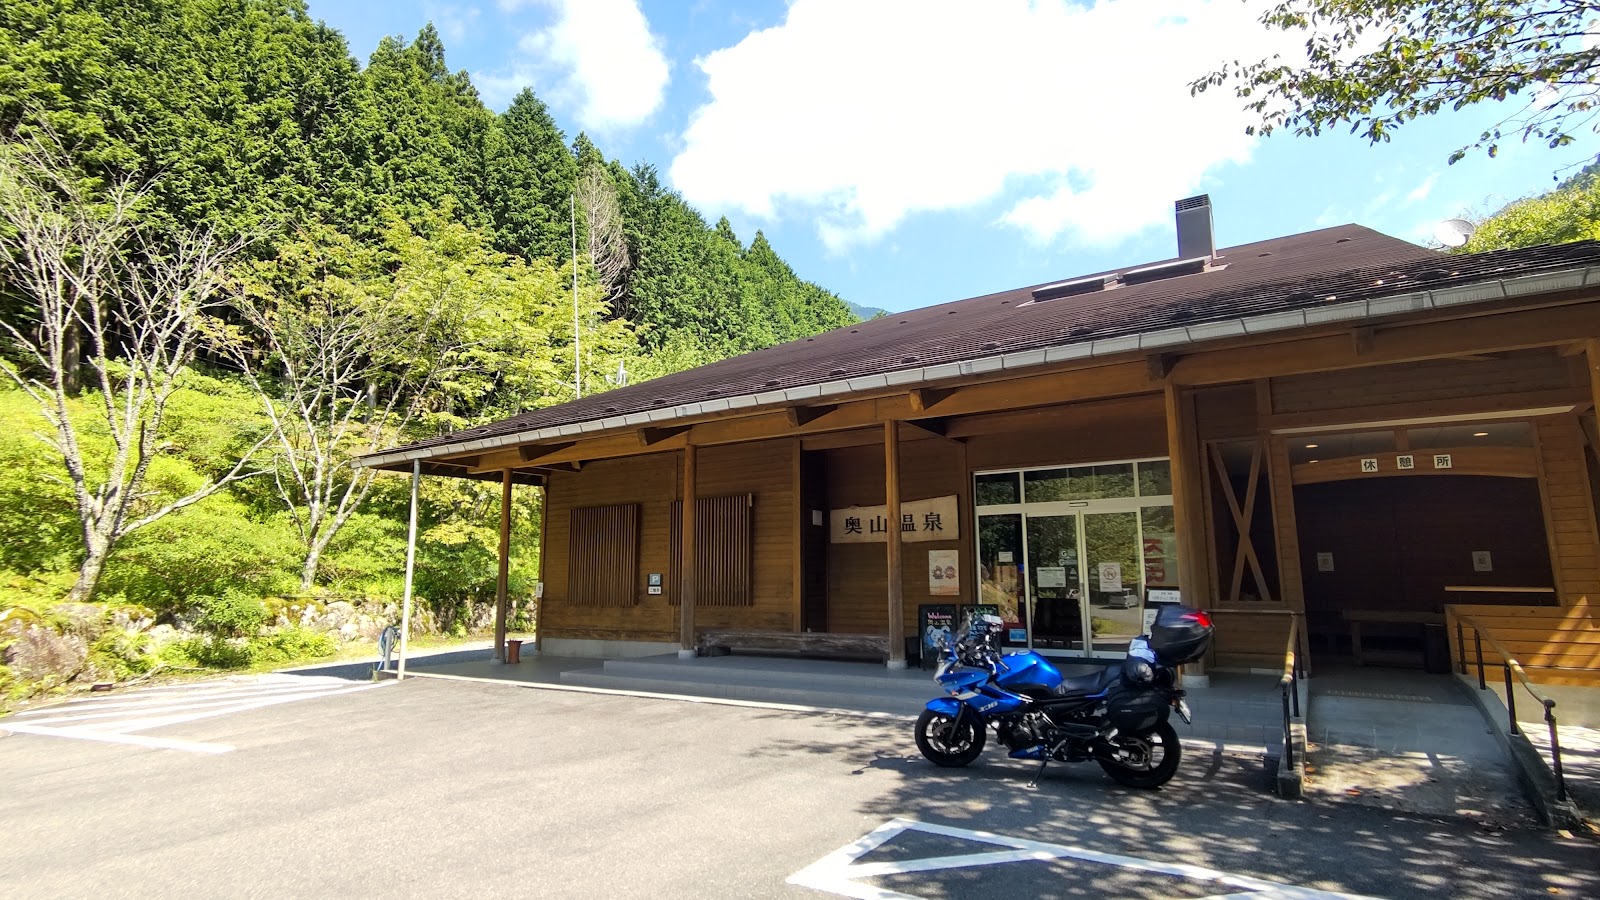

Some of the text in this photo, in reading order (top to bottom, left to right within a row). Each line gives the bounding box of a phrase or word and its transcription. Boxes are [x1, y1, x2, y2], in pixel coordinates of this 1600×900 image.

[1363, 456, 1449, 470] 休憩所
[844, 512, 943, 534] 奥山温泉
[652, 575, 659, 583] P
